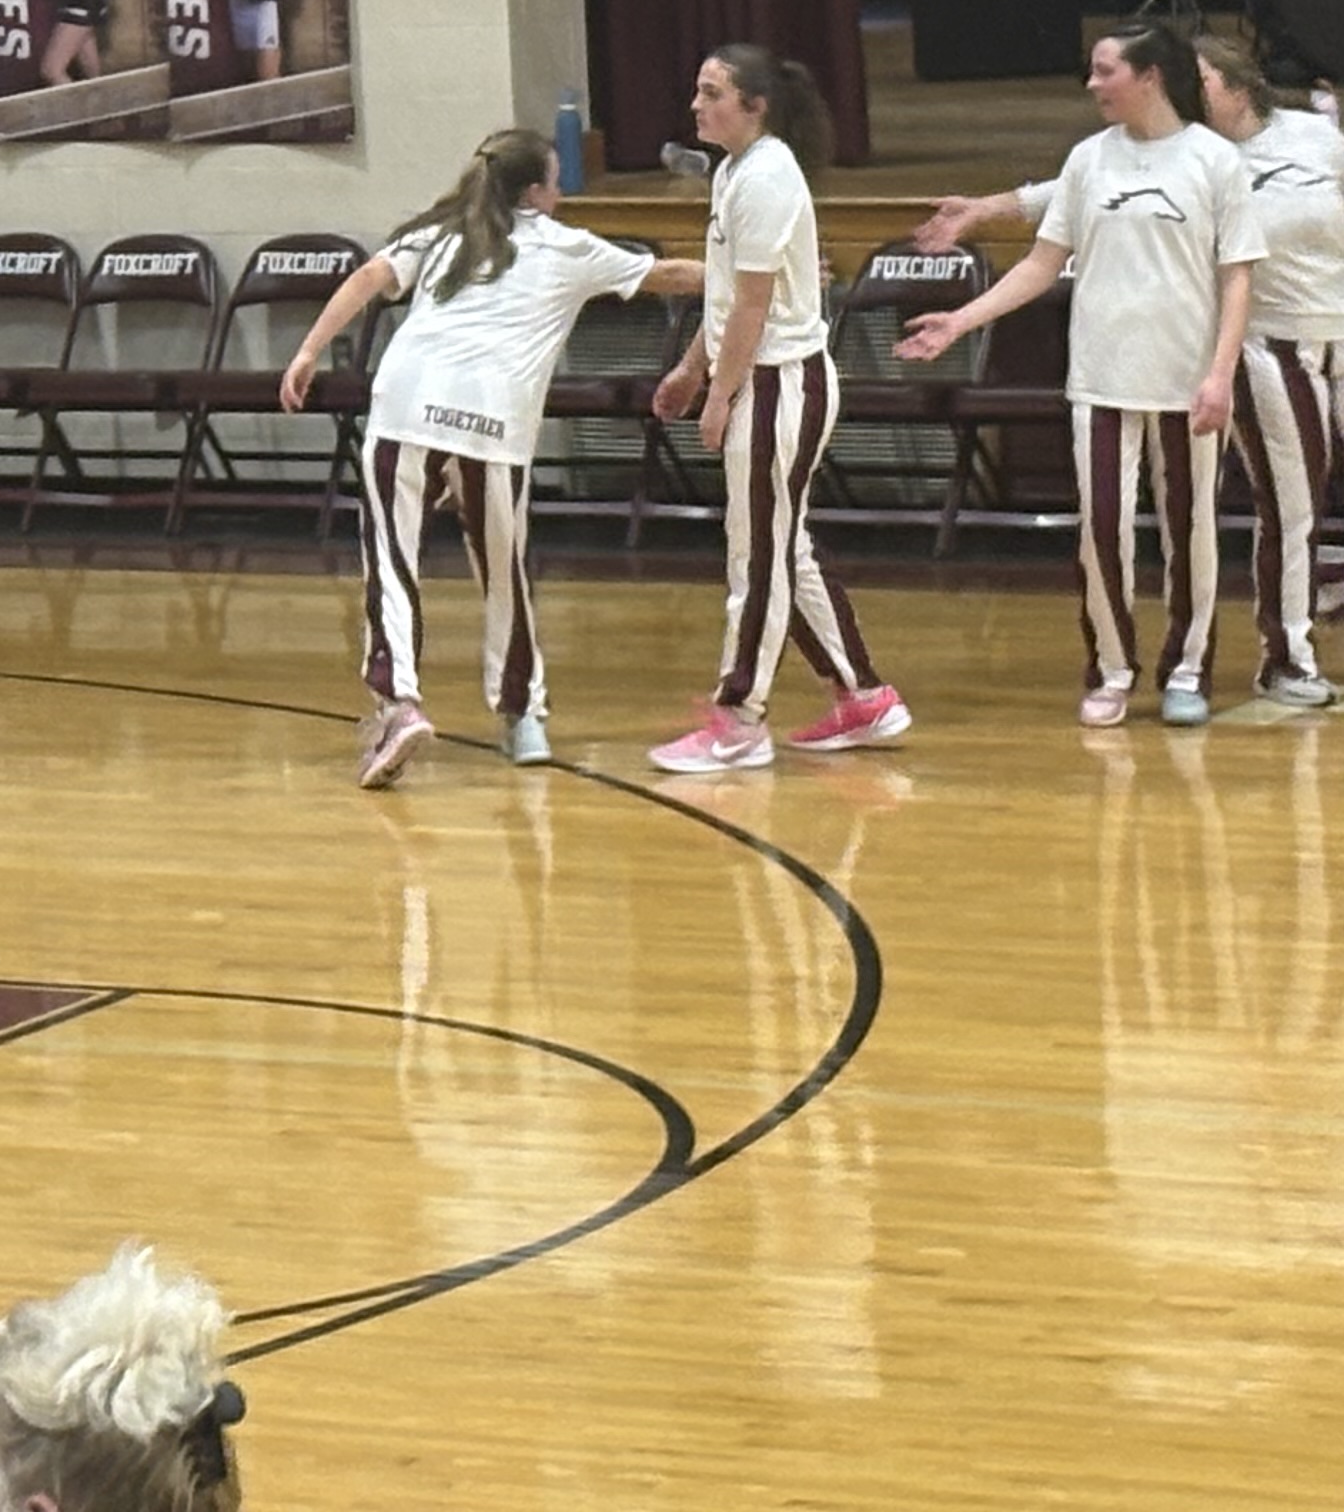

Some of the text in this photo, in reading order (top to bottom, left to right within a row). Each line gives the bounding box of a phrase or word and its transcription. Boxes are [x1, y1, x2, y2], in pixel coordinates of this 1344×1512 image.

[101, 252, 199, 276] FOXCROFT
[255, 250, 353, 275] FOXCROFT
[869, 255, 973, 280] FOXCROFT
[423, 404, 505, 439] TOGETHER
